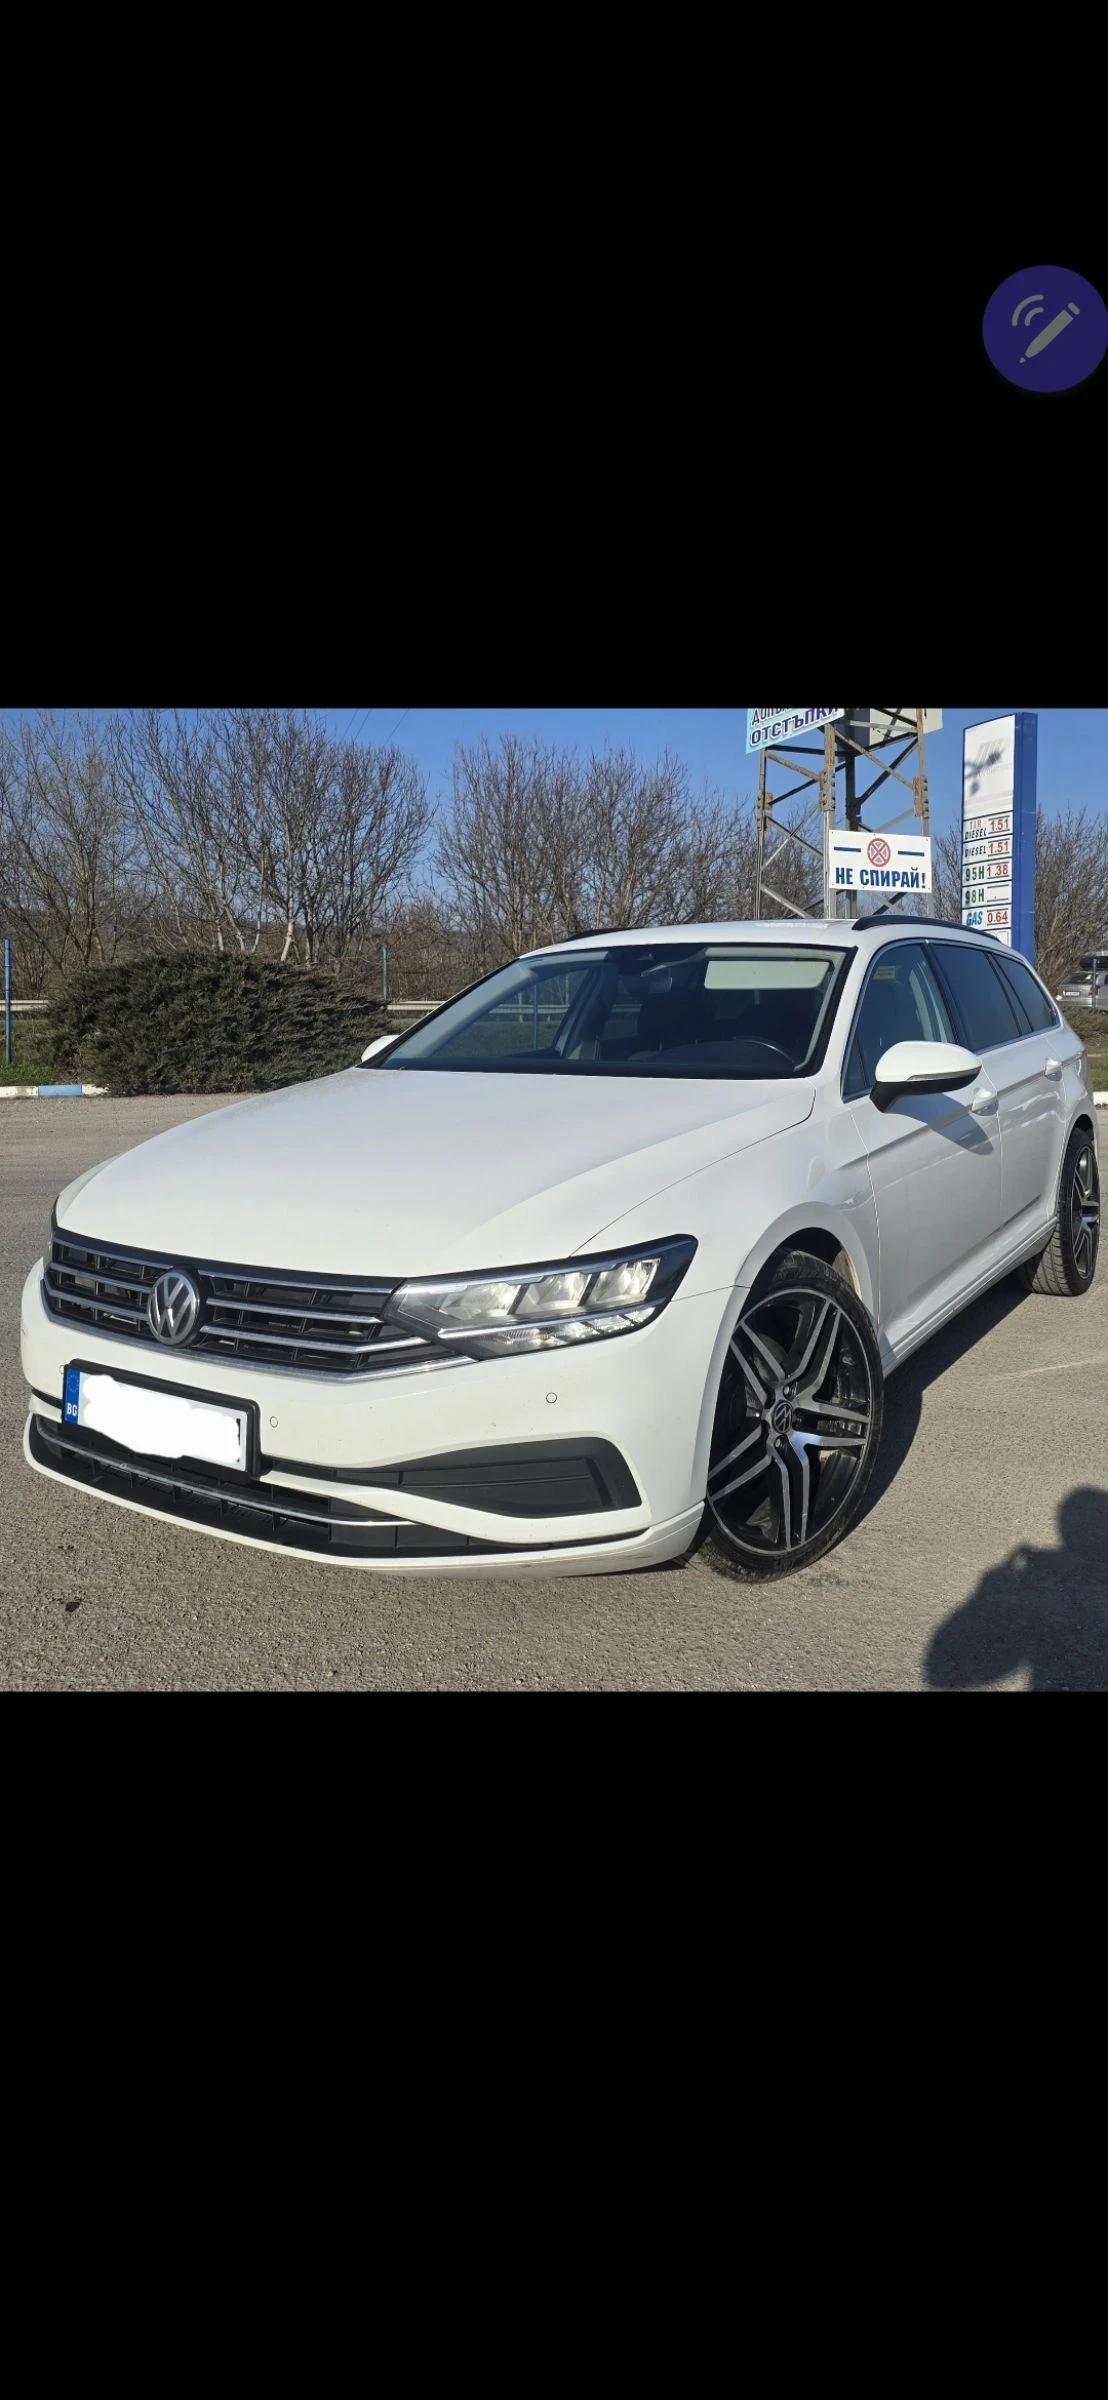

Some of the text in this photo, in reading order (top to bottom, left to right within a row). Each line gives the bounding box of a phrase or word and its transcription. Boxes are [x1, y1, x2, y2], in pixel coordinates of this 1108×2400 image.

[990, 818, 1009, 831] 1.51
[965, 828, 986, 840] DIESEL
[965, 841, 1009, 857] DIESEL 1.51
[835, 866, 926, 889] НЕ СПИРАЙ!
[965, 865, 985, 882] 95H
[965, 888, 985, 904] 98H
[966, 911, 1008, 926] GAS 0.64
[66, 1403, 78, 1417] BG
